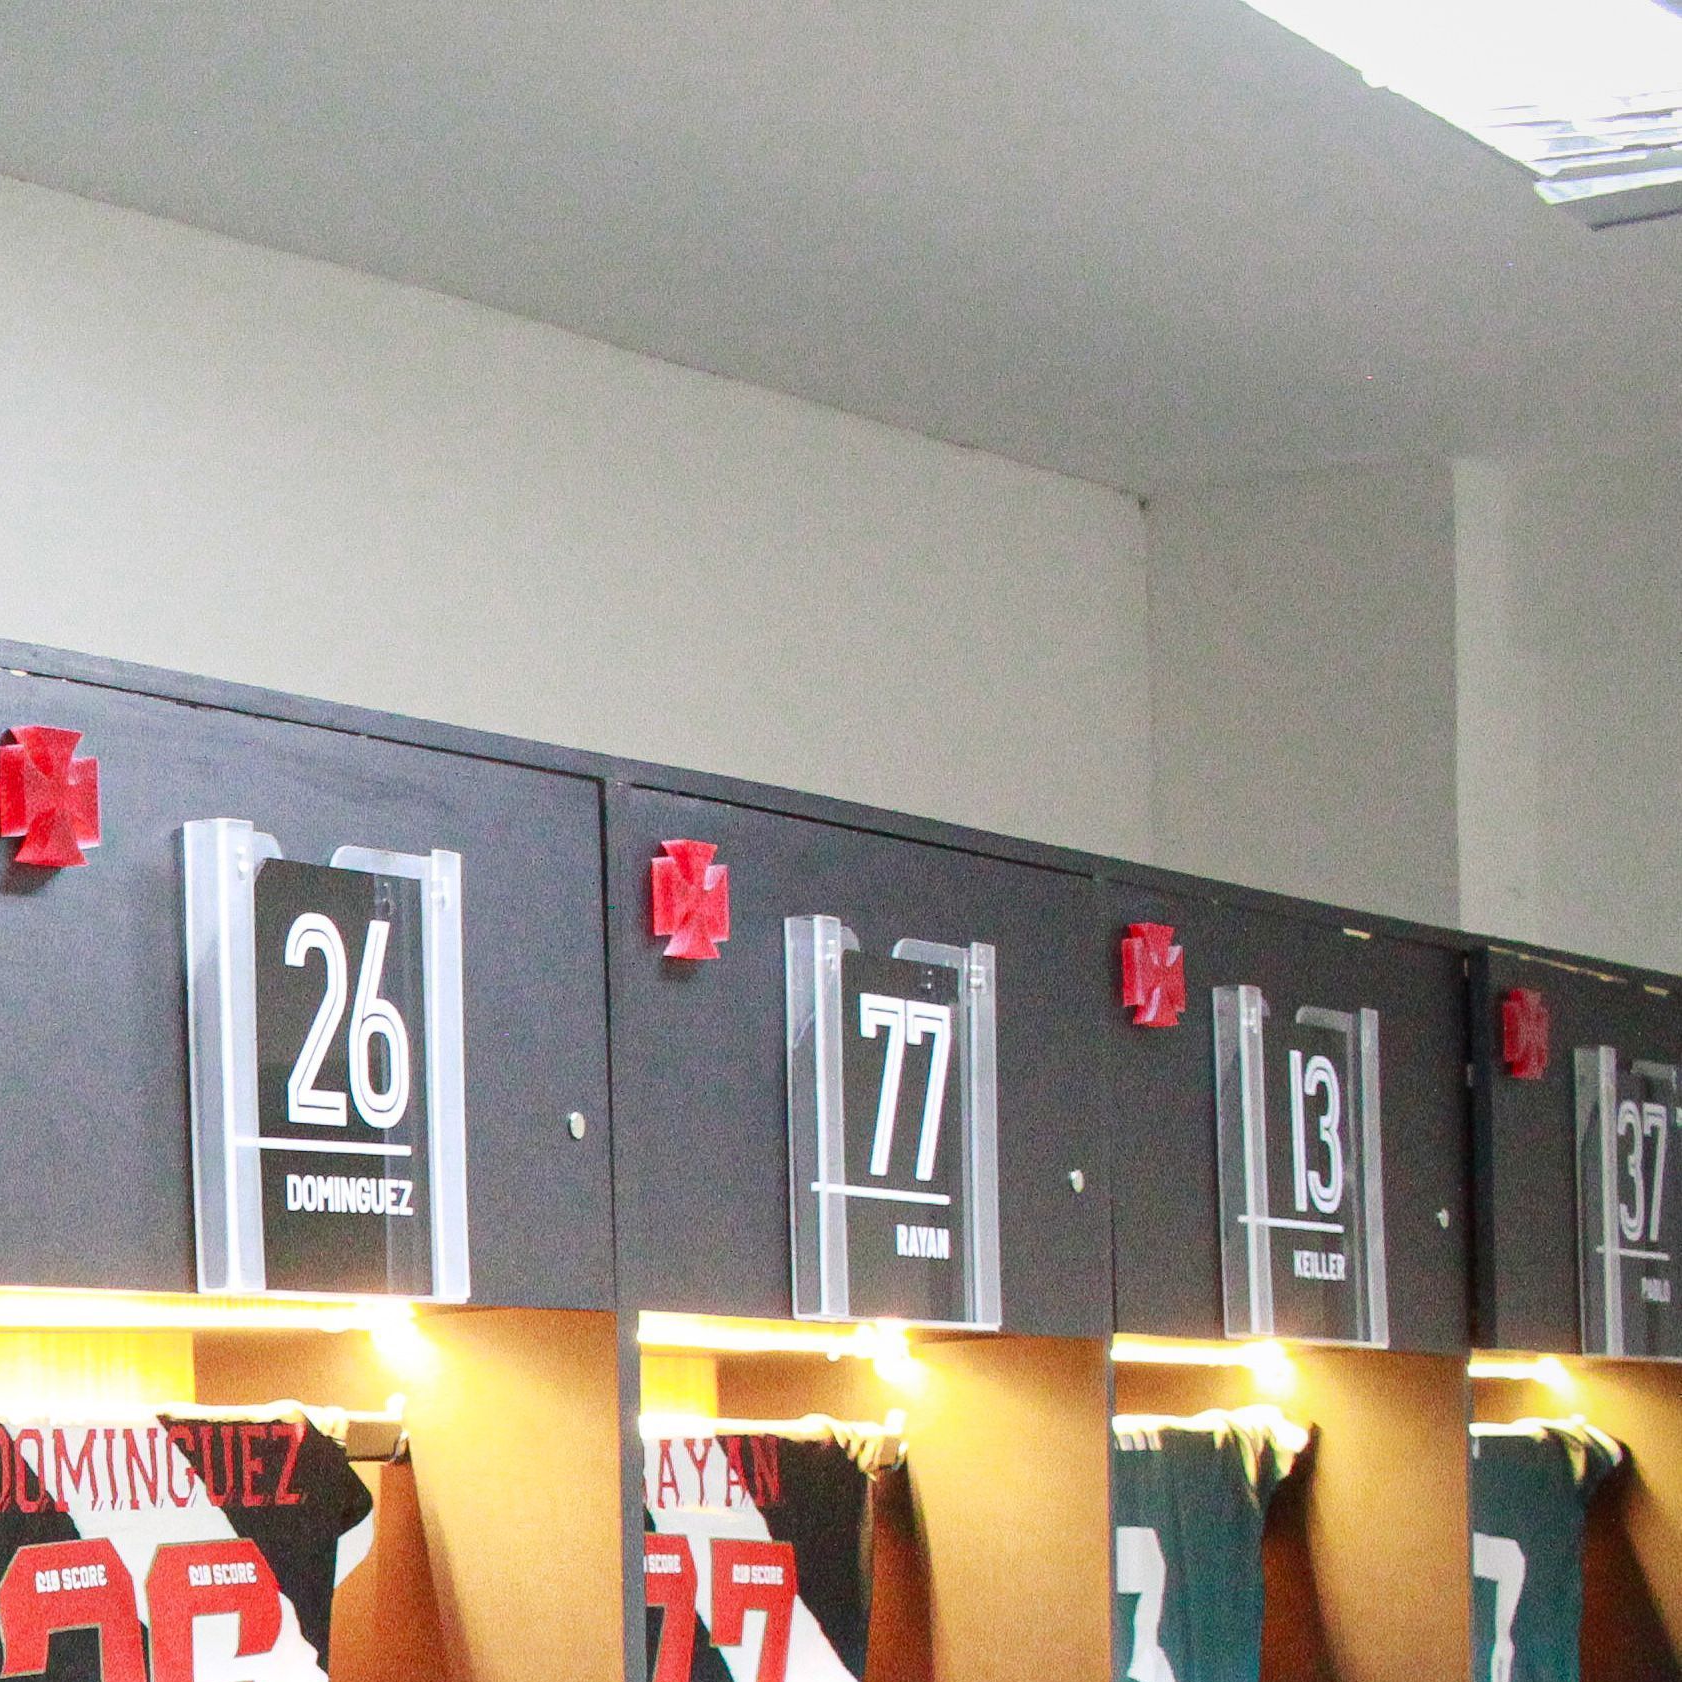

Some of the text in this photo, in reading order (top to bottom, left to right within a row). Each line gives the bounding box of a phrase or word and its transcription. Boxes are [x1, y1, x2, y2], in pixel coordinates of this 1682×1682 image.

[284, 911, 411, 1131] 26
[859, 992, 953, 1182] 77
[1289, 1048, 1344, 1215] 13
[285, 1173, 414, 1217] DOMINGUEZ
[1617, 1099, 1668, 1243] 37
[896, 1223, 950, 1260] RAYAN
[643, 1434, 779, 1508] AYAN
[61, 1564, 108, 1591] SCORE
[212, 1561, 258, 1586] SCORE
